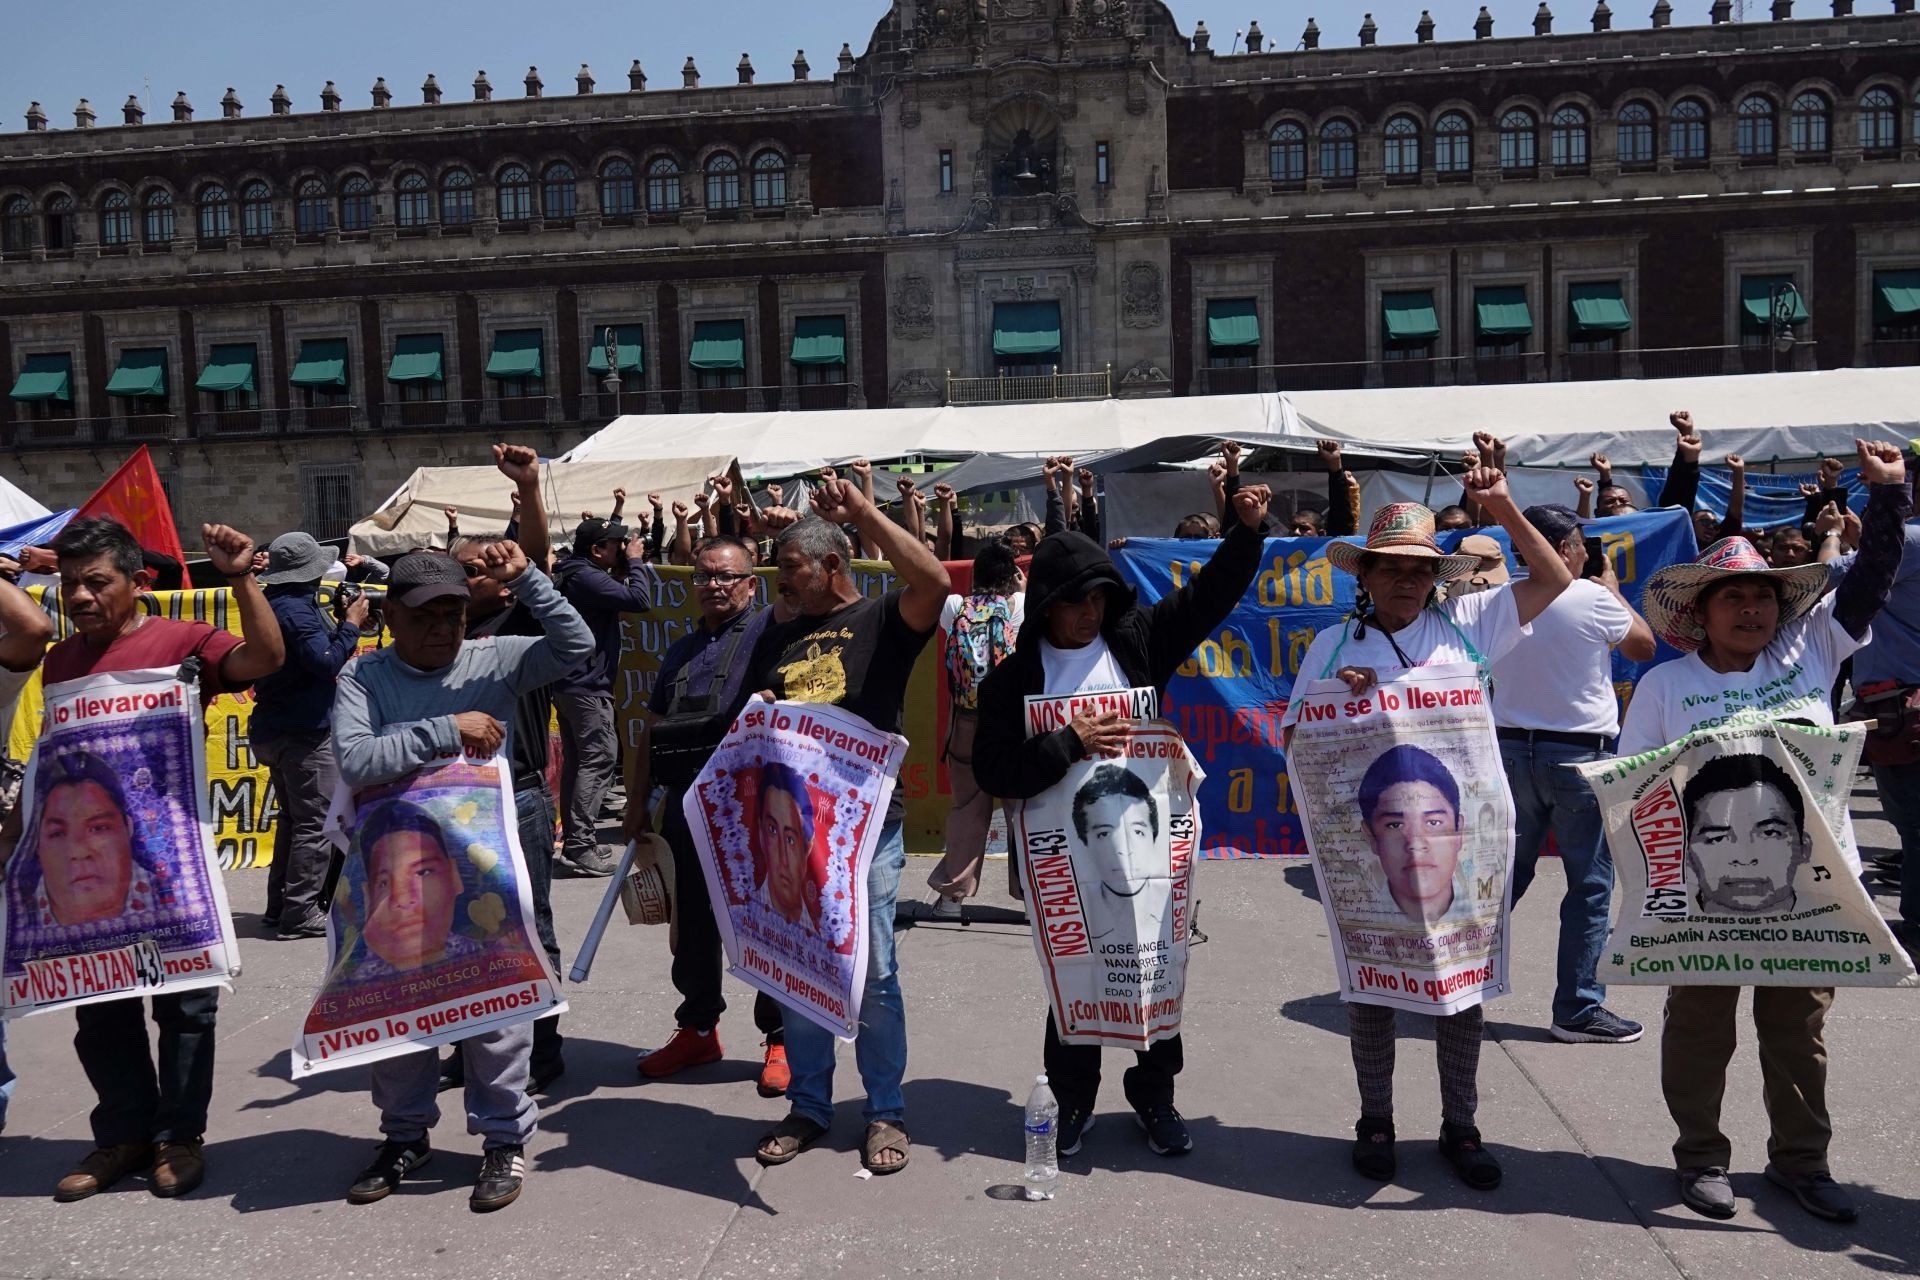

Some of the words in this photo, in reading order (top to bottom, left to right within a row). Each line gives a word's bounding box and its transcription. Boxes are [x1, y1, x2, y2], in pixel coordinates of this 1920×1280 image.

[1258, 549, 1333, 607] día
[76, 685, 183, 720] llevaron!
[1345, 698, 1371, 718] se
[1377, 690, 1400, 711] lo
[744, 708, 765, 728] se
[769, 708, 791, 731] lo
[796, 714, 888, 764] llevaron!
[1632, 773, 1660, 801] NUNCA
[1692, 735, 1715, 748] QUE
[1716, 732, 1729, 742] TE
[1731, 729, 1777, 740] ESTAMOS
[1028, 828, 1069, 856] 43!
[1170, 813, 1194, 840] 43!
[1638, 816, 1683, 888] FALTAN
[1033, 855, 1079, 918] FALTAN
[1171, 840, 1191, 901] FALTAN
[1642, 888, 1687, 917] 43!
[1687, 915, 1736, 925] ESPERES
[1738, 915, 1762, 925] QUE
[1764, 915, 1779, 924] TE
[1780, 903, 1842, 922] OLVIDEMOS
[1048, 920, 1089, 957] NOS
[1174, 905, 1186, 942] NOS
[1346, 931, 1395, 947] CHRISTIAN
[1400, 934, 1435, 950] TOMÁS
[1630, 928, 1704, 948] BENJAMÍN
[1707, 929, 1788, 942] ASCENCIO
[1792, 929, 1871, 944] BAUTISTA
[1100, 942, 1134, 954] JOSÉ
[1105, 954, 1169, 968] NAVARRETE
[1630, 957, 1674, 976] ¡Con
[1678, 954, 1731, 972] VIDA
[1734, 954, 1754, 971] lo
[1760, 956, 1871, 975] queremos!
[28, 959, 69, 1001] NOS
[68, 948, 136, 995] FALTAN
[134, 942, 166, 988] 43!
[400, 966, 481, 997] FRANCISCO
[488, 957, 538, 973] ARZOLA
[743, 946, 770, 975] ¡Vivo
[772, 960, 783, 982] lo
[785, 971, 846, 1019] queremos!
[1358, 966, 1398, 990] ¡Vivo
[1402, 972, 1419, 993] lo
[1424, 959, 1494, 1001] queremos!
[1105, 987, 1133, 997] EDAD
[318, 1025, 380, 1059] ¡Vivo
[386, 1019, 410, 1038] lo
[416, 983, 541, 1035] queremos!
[1069, 1000, 1099, 1023] ¡Con
[1100, 1001, 1132, 1024] VIDA
